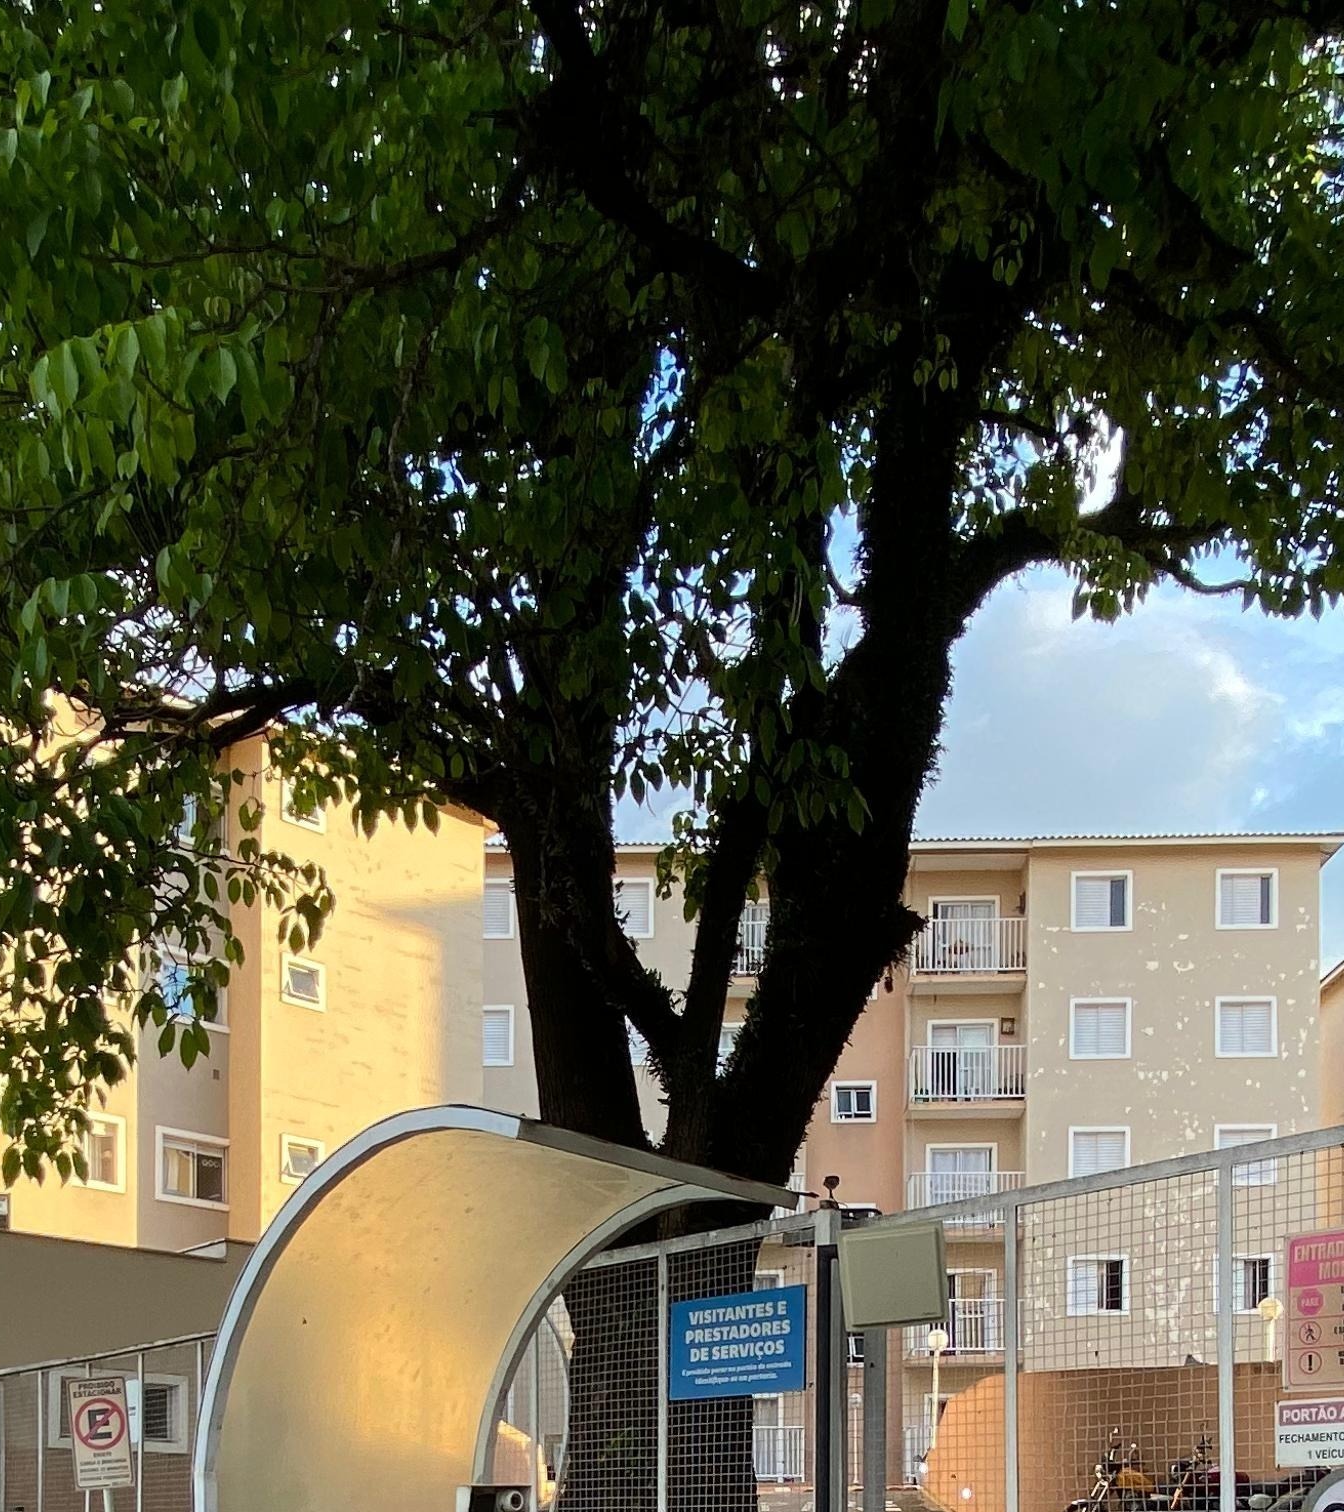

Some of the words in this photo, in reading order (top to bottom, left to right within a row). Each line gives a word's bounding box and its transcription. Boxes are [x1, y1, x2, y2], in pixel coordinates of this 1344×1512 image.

[689, 1302, 774, 1326] VISITANTES
[777, 1301, 787, 1315] E
[685, 1320, 791, 1344] PRESTADORES
[690, 1347, 709, 1362] DE
[712, 1340, 784, 1360] SERVIÇOS
[73, 1387, 121, 1398] ESTACIONAR
[78, 1380, 115, 1390] PROIBIDO
[1282, 1403, 1337, 1423] PORTÃO
[88, 1408, 112, 1440] E
[1308, 1450, 1312, 1459] 1
